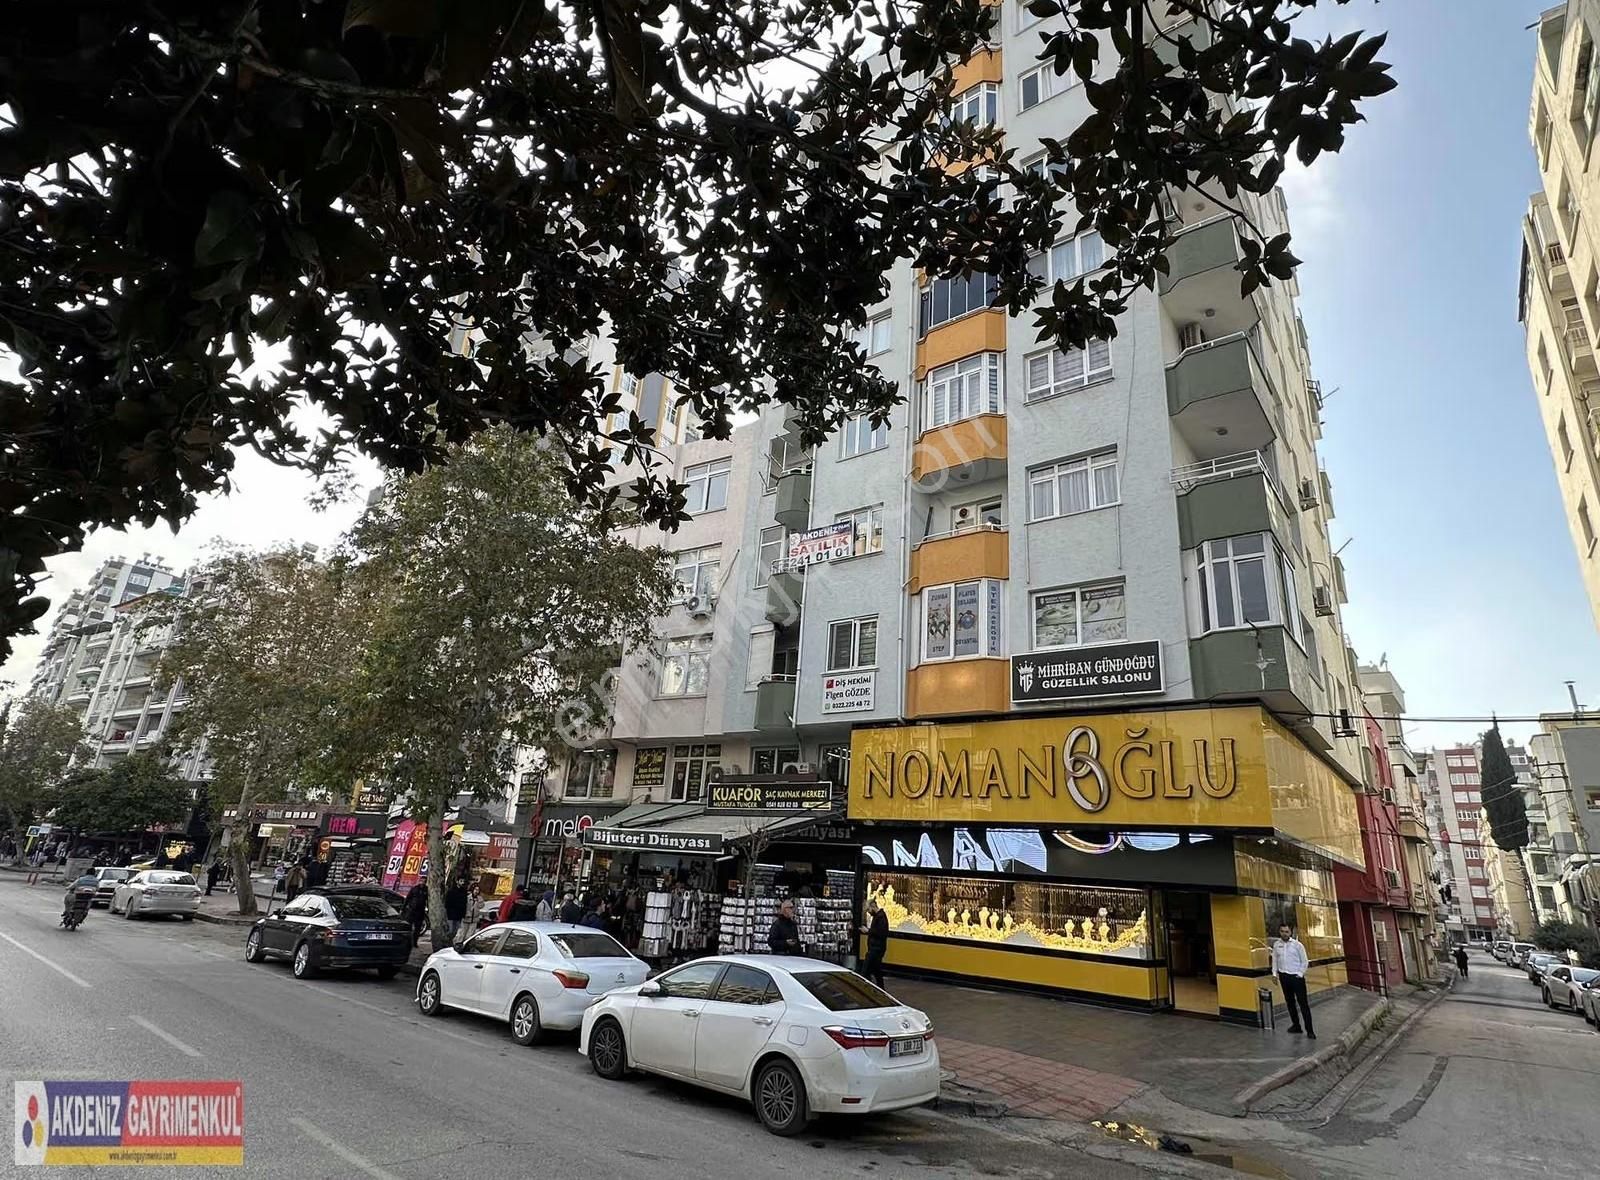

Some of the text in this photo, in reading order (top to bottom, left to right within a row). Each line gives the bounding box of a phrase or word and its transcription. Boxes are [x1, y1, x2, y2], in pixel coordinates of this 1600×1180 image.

[790, 536, 849, 557] SATILIK
[815, 551, 830, 561] 01
[835, 547, 850, 557] 01
[1038, 655, 1155, 678] MİHRİBAN GÜNDOĞDU
[1102, 672, 1151, 684] SALONU
[845, 687, 871, 697] GÖZDE
[713, 784, 761, 801] KUAFÖR
[801, 788, 828, 797] MERKEZİ
[545, 814, 610, 838] melo
[593, 830, 711, 848] Bijuteri Dünyası
[393, 842, 406, 852] AL
[410, 842, 423, 852] AL
